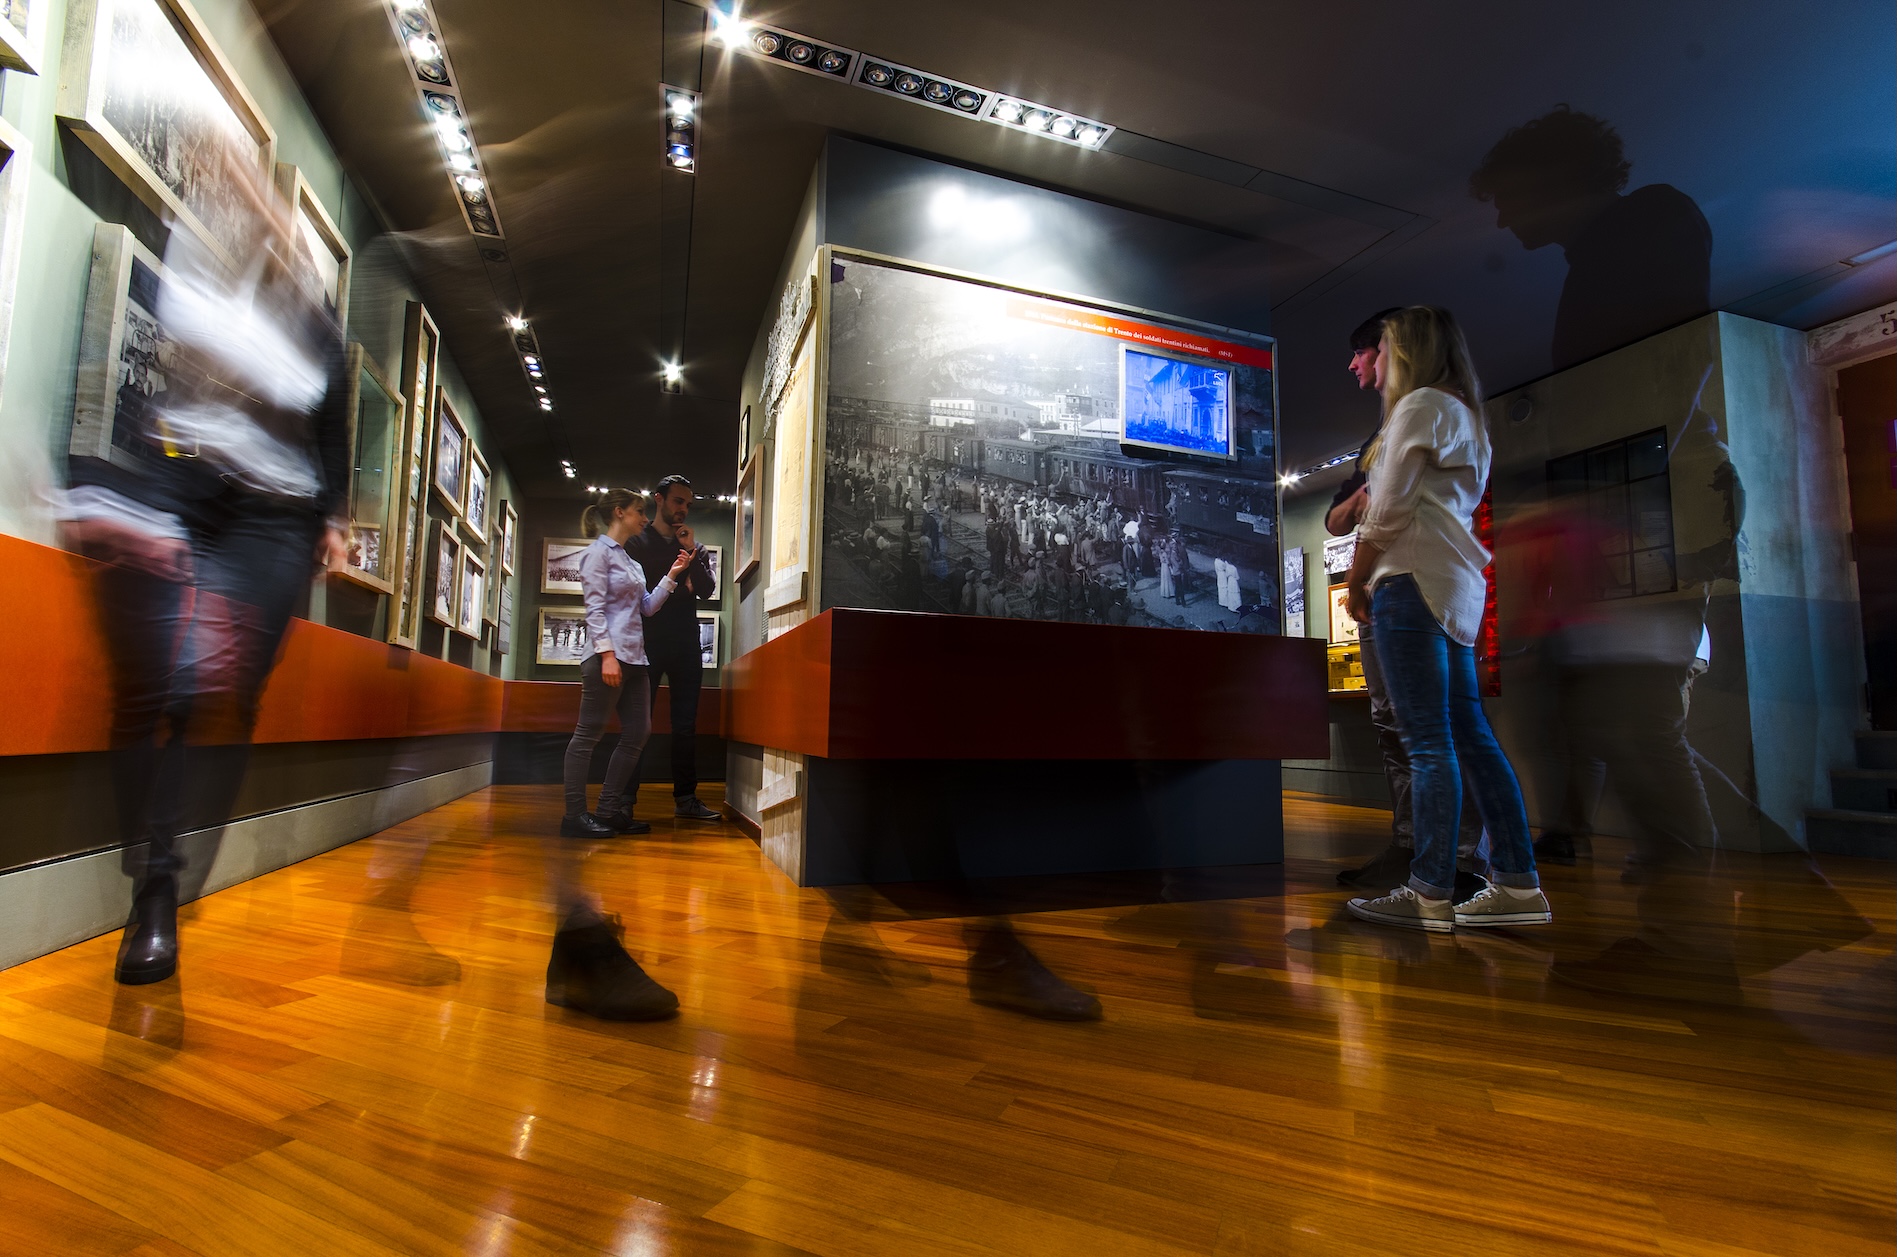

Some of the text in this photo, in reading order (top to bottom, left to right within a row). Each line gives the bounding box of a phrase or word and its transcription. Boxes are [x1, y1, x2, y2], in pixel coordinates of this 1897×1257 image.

[1879, 309, 1897, 336] 5
[1083, 322, 1106, 332] stazione
[1107, 326, 1113, 334] di
[1114, 327, 1132, 337] Trento
[1133, 331, 1142, 339] dei
[1143, 334, 1161, 343] soldati
[1162, 338, 1182, 347] trentini
[1183, 342, 1210, 353] richiamati.
